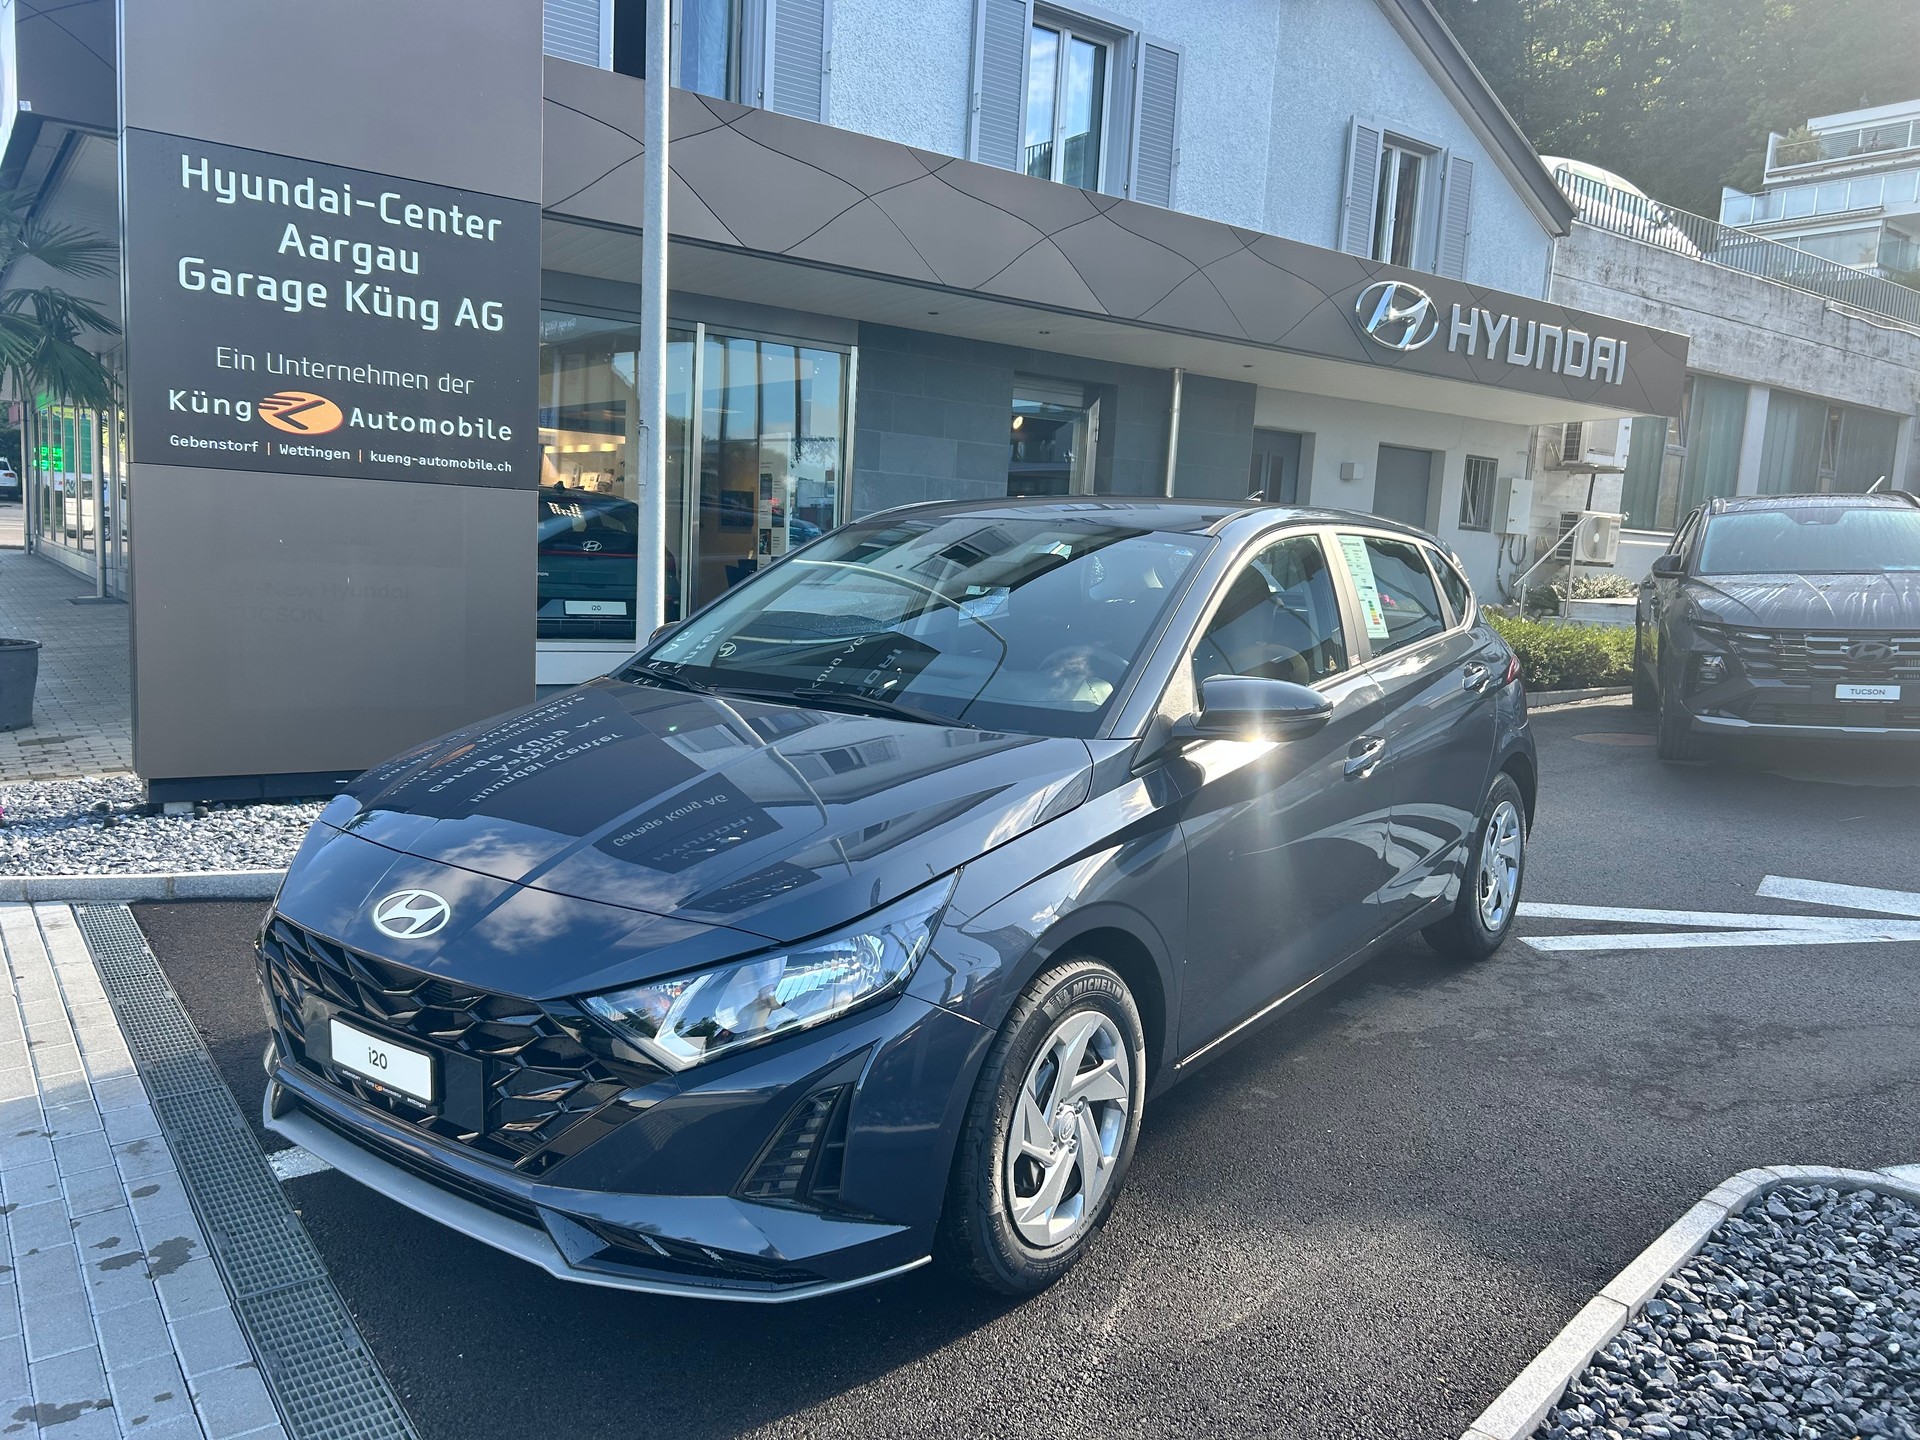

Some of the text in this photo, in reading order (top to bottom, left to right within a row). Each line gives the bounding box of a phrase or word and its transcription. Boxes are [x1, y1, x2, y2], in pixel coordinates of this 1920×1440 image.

[181, 153, 502, 242] Hyundai-Center
[277, 222, 420, 276] Aargau
[178, 256, 328, 313] Garage
[345, 280, 440, 331] Küng
[454, 297, 504, 332] AG
[216, 346, 475, 395] Ein Unternehmen der
[1448, 303, 1628, 385] HYUNDAI
[168, 389, 252, 422] Küng
[349, 407, 513, 442] Automobile
[170, 434, 512, 473] Gebenstorf Wettingen kueng-automobile.ch
[1072, 978, 1123, 999] MICHELIN
[368, 1046, 388, 1069] i20
